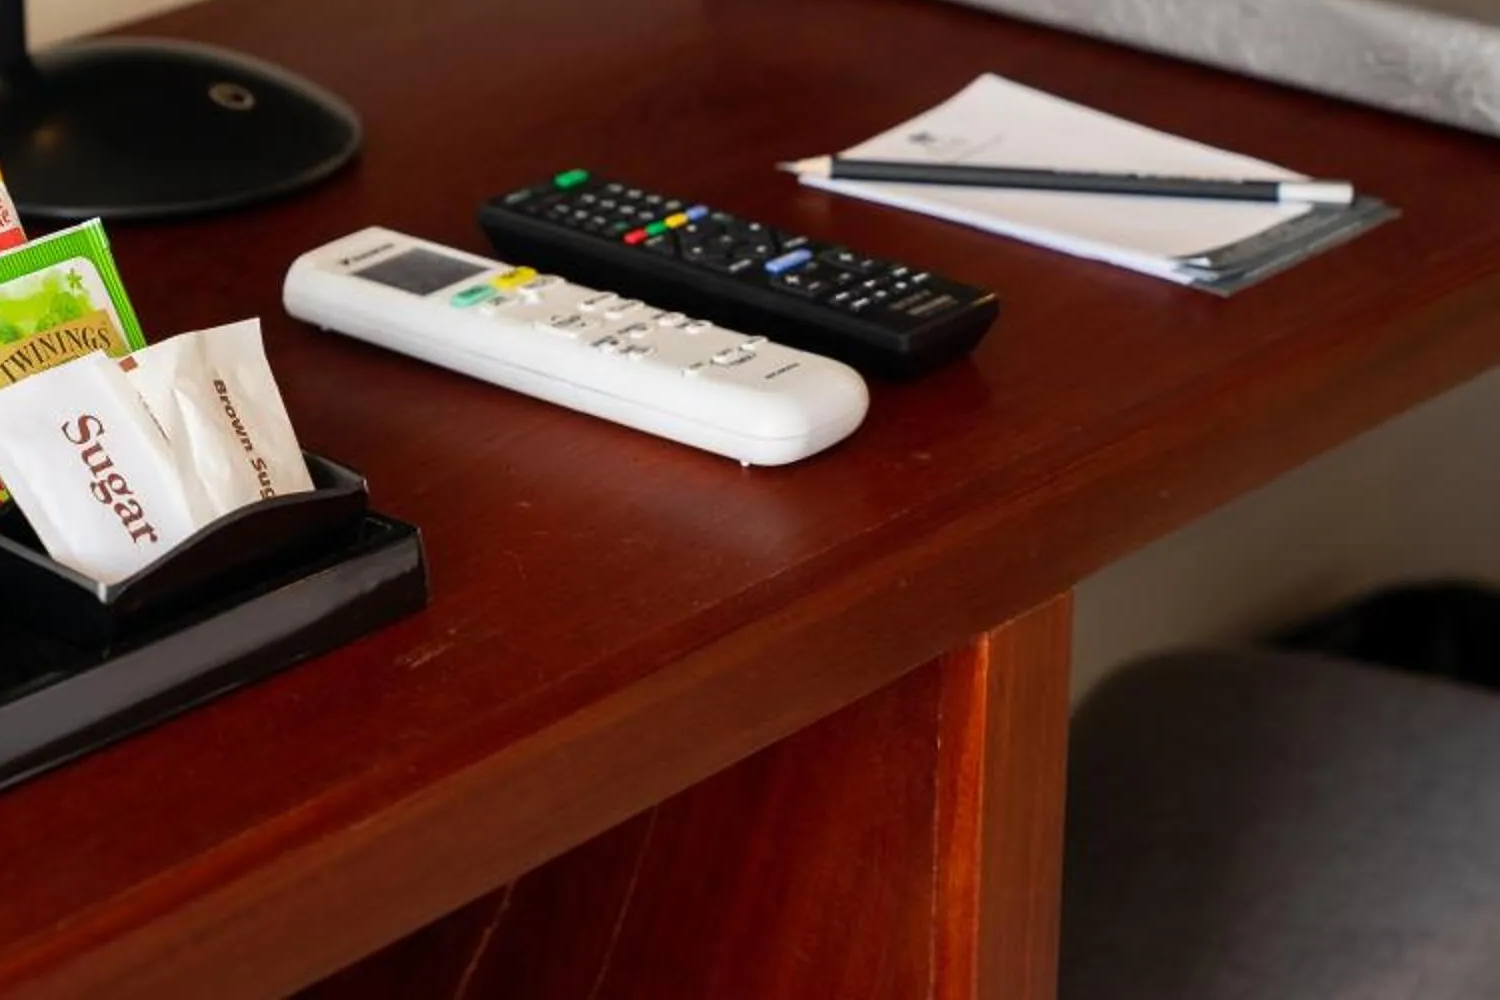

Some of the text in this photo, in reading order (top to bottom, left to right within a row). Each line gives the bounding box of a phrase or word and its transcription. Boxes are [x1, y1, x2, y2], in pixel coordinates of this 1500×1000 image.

[61, 414, 158, 543] Sugar
[213, 379, 276, 501] Brown Sug
